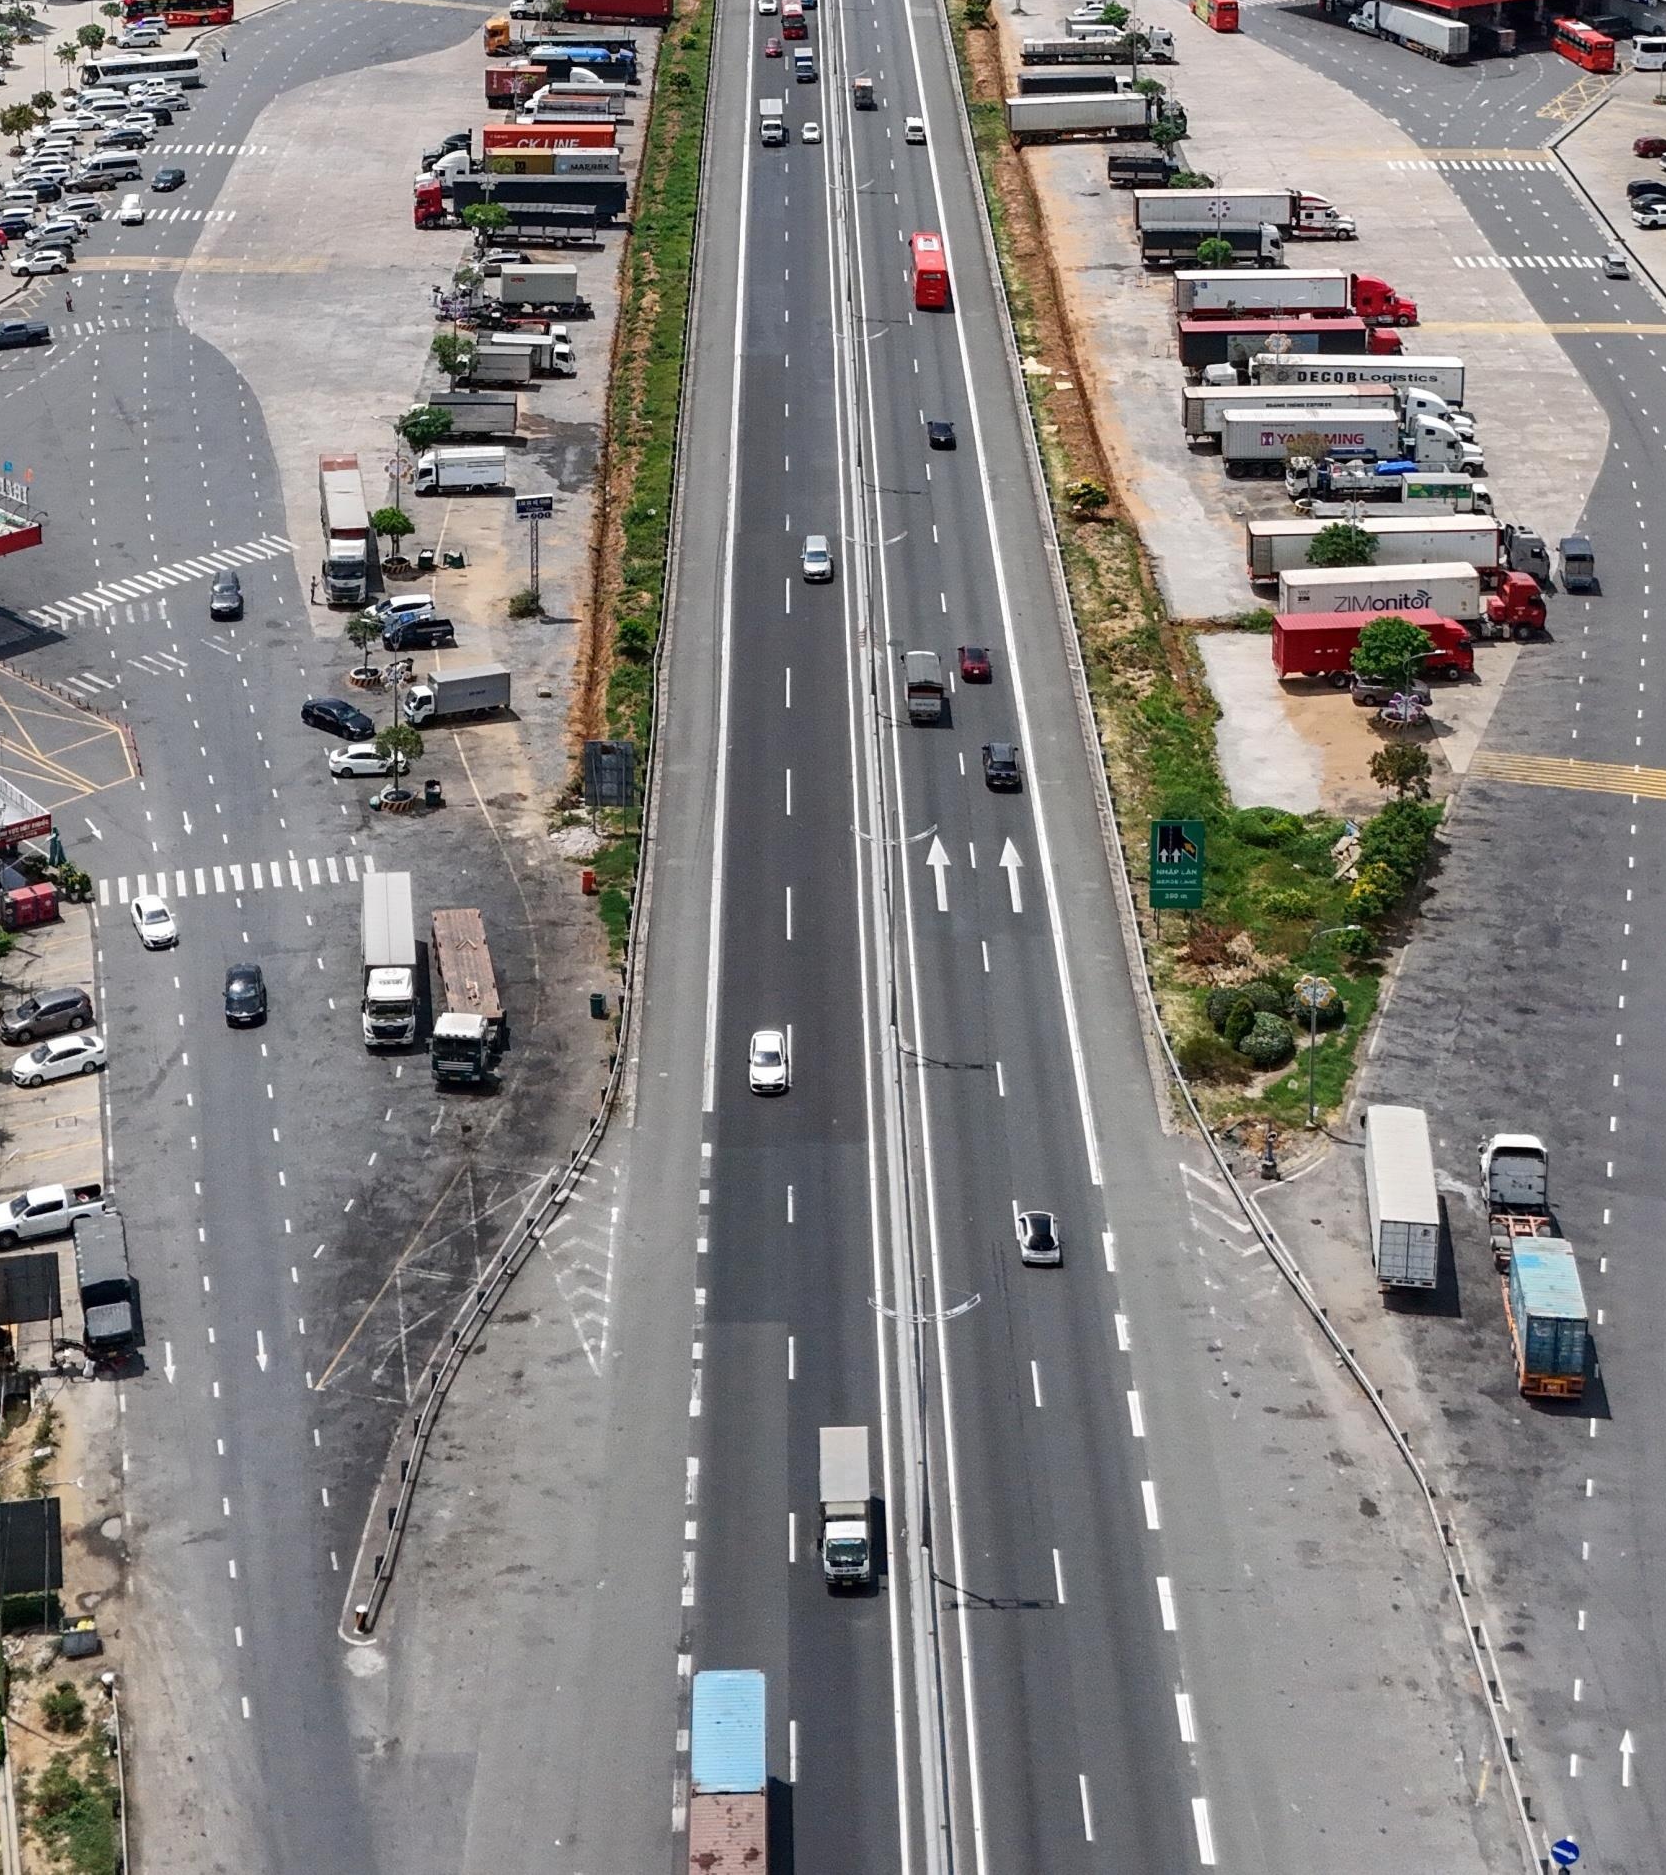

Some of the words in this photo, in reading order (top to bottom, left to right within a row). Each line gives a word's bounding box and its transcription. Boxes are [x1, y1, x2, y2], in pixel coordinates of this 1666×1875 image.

[1359, 372, 1438, 384] Logistics
[1324, 433, 1365, 445] MING
[1334, 591, 1432, 613] ZIMonitor
